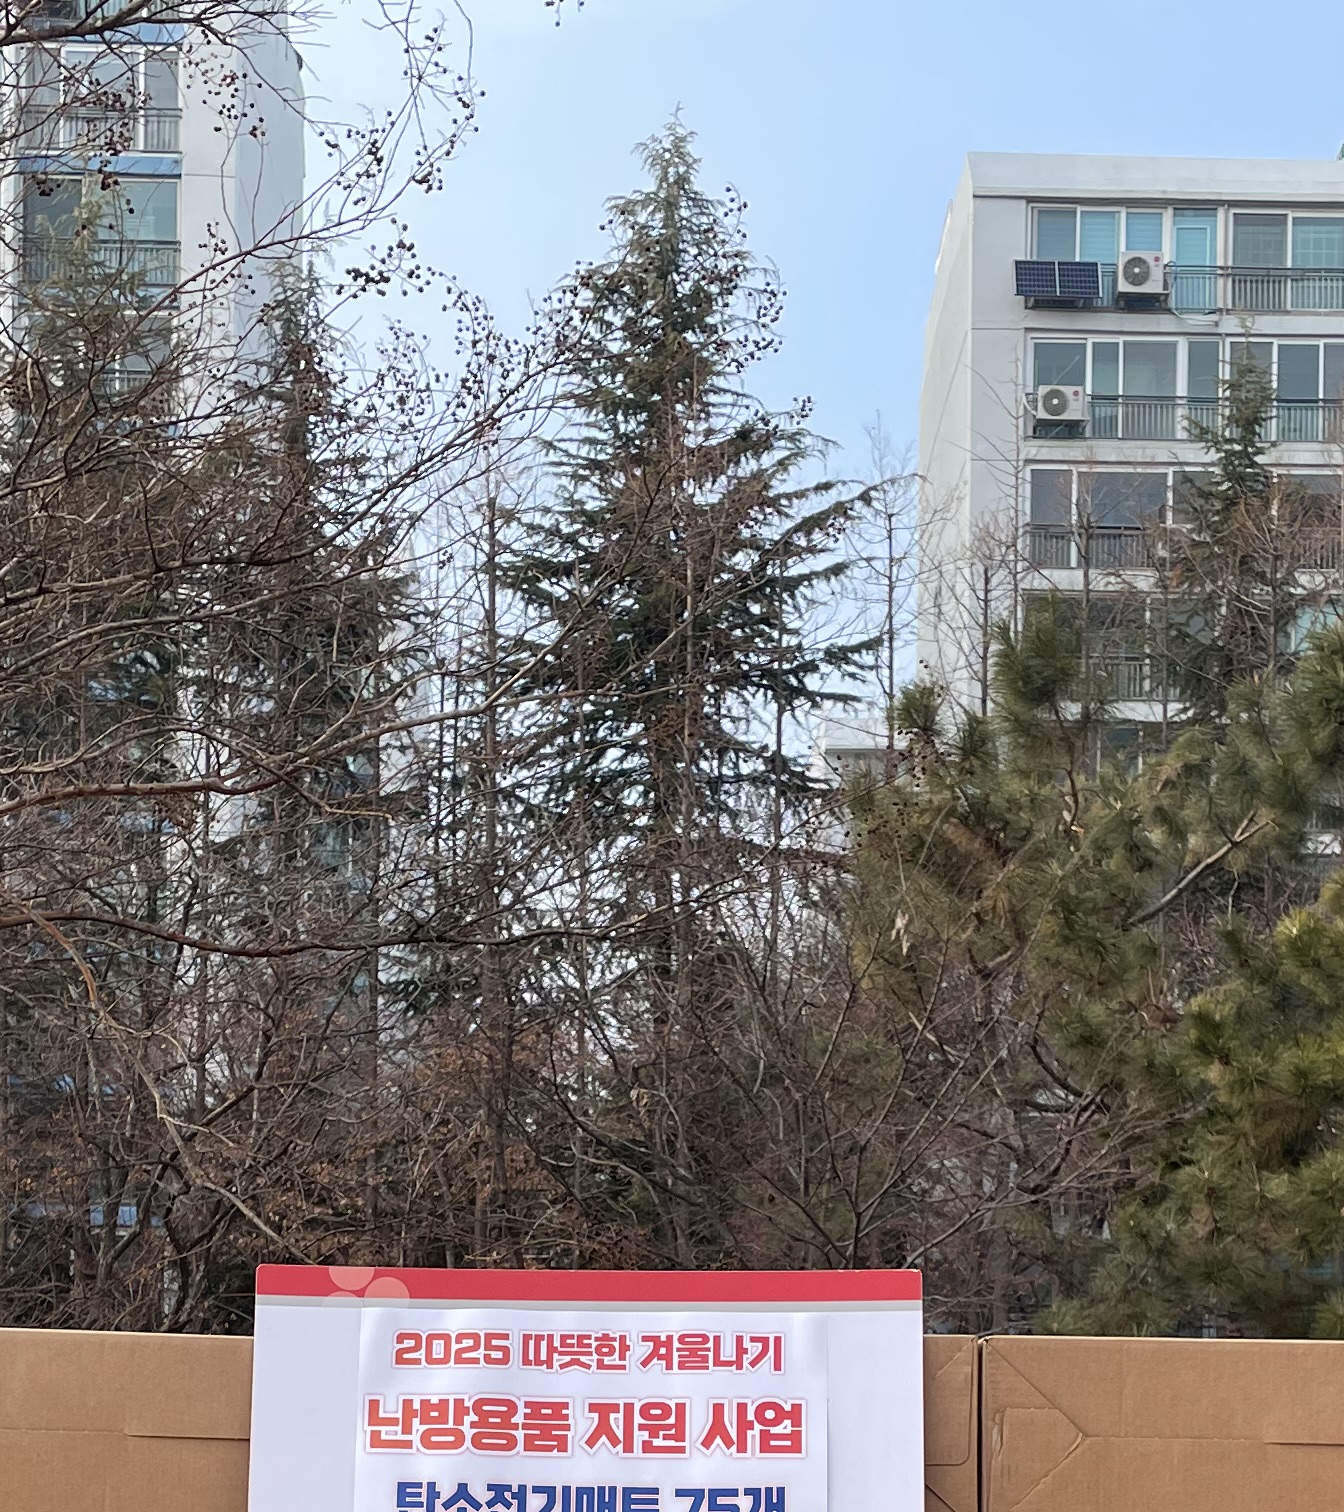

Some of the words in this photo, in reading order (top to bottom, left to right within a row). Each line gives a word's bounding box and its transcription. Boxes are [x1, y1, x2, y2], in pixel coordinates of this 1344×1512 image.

[395, 1331, 511, 1368] 2025
[521, 1332, 631, 1372] 따뜻한
[639, 1333, 784, 1373] 겨울나기
[366, 1397, 573, 1454] 난방용품
[583, 1400, 687, 1455] 지원
[699, 1400, 804, 1455] 사업
